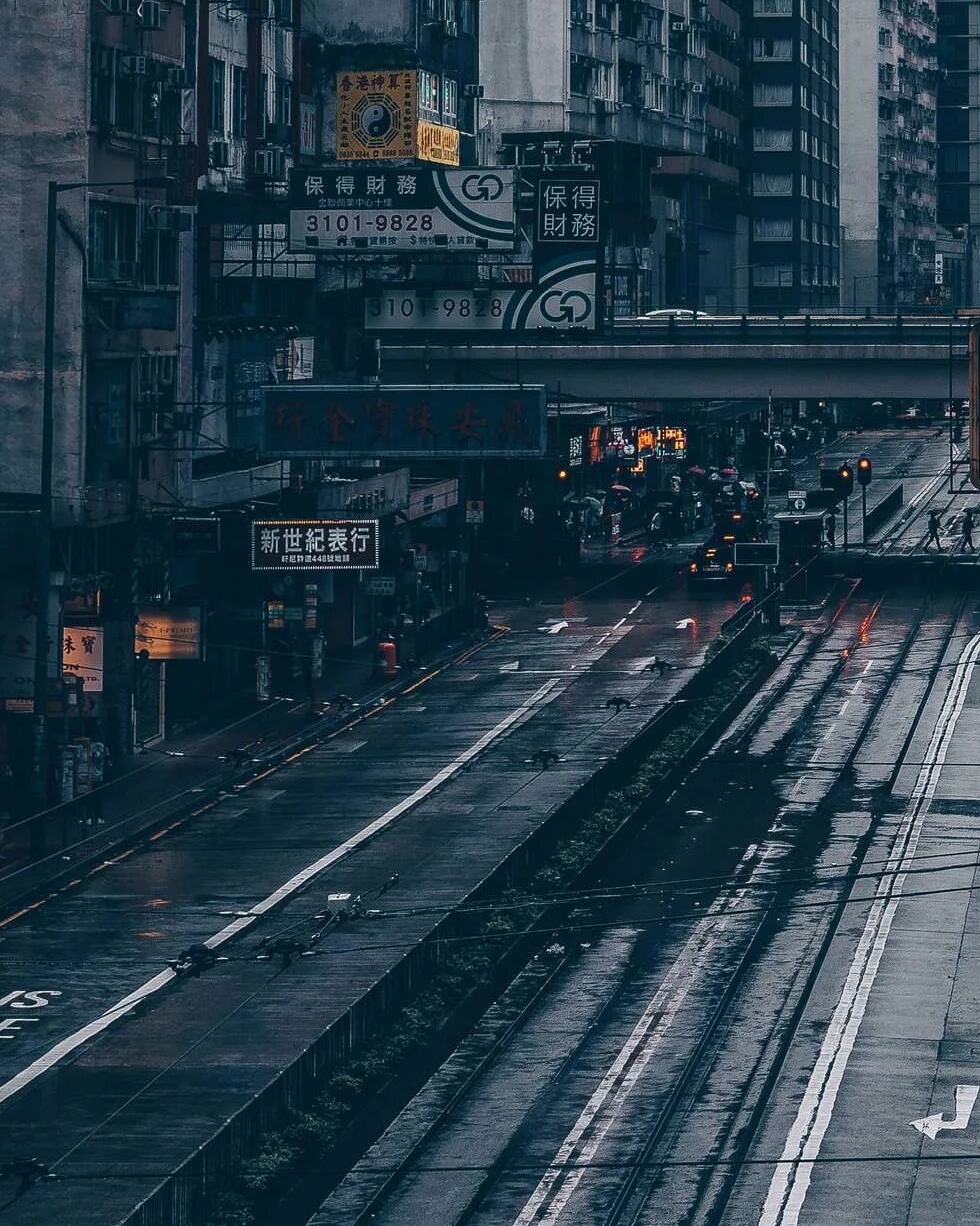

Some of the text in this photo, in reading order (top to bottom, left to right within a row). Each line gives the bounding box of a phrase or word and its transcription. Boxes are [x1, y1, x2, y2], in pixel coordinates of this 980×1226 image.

[304, 175, 417, 197] 保得財務
[306, 214, 434, 232] 3101-9828
[368, 298, 503, 319] 3101-9828
[260, 526, 370, 554] 新世紀表行
